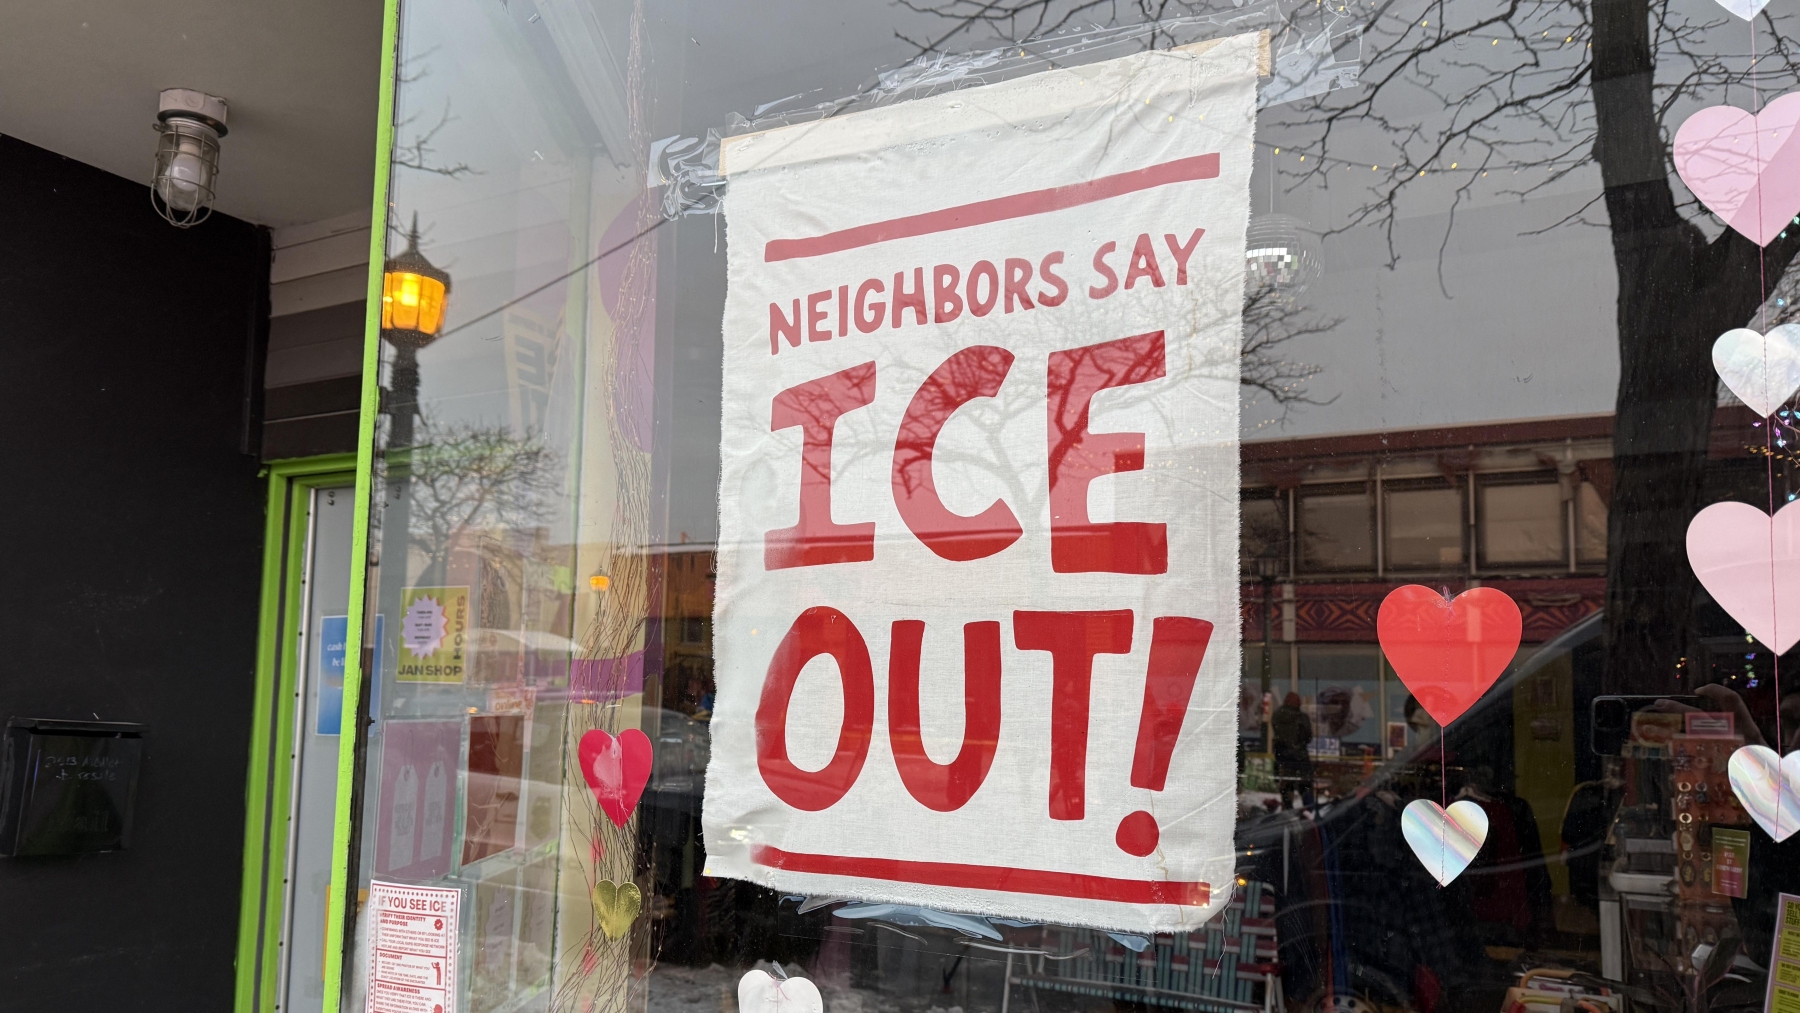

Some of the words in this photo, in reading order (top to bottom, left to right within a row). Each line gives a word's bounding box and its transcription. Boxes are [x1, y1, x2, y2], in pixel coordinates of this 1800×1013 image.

[769, 250, 1069, 355] NEIGHBORS
[1088, 228, 1206, 300] SAY
[764, 330, 1168, 575] ICE
[453, 596, 465, 660] HOURS
[398, 665, 424, 676] JAN
[425, 665, 462, 676] SHOP
[754, 605, 1214, 858] OUT!
[378, 895, 386, 907] IF
[388, 896, 407, 909] YOU
[409, 899, 427, 911] SEE
[430, 901, 446, 913] ICE
[393, 986, 420, 994] AWARENESS
